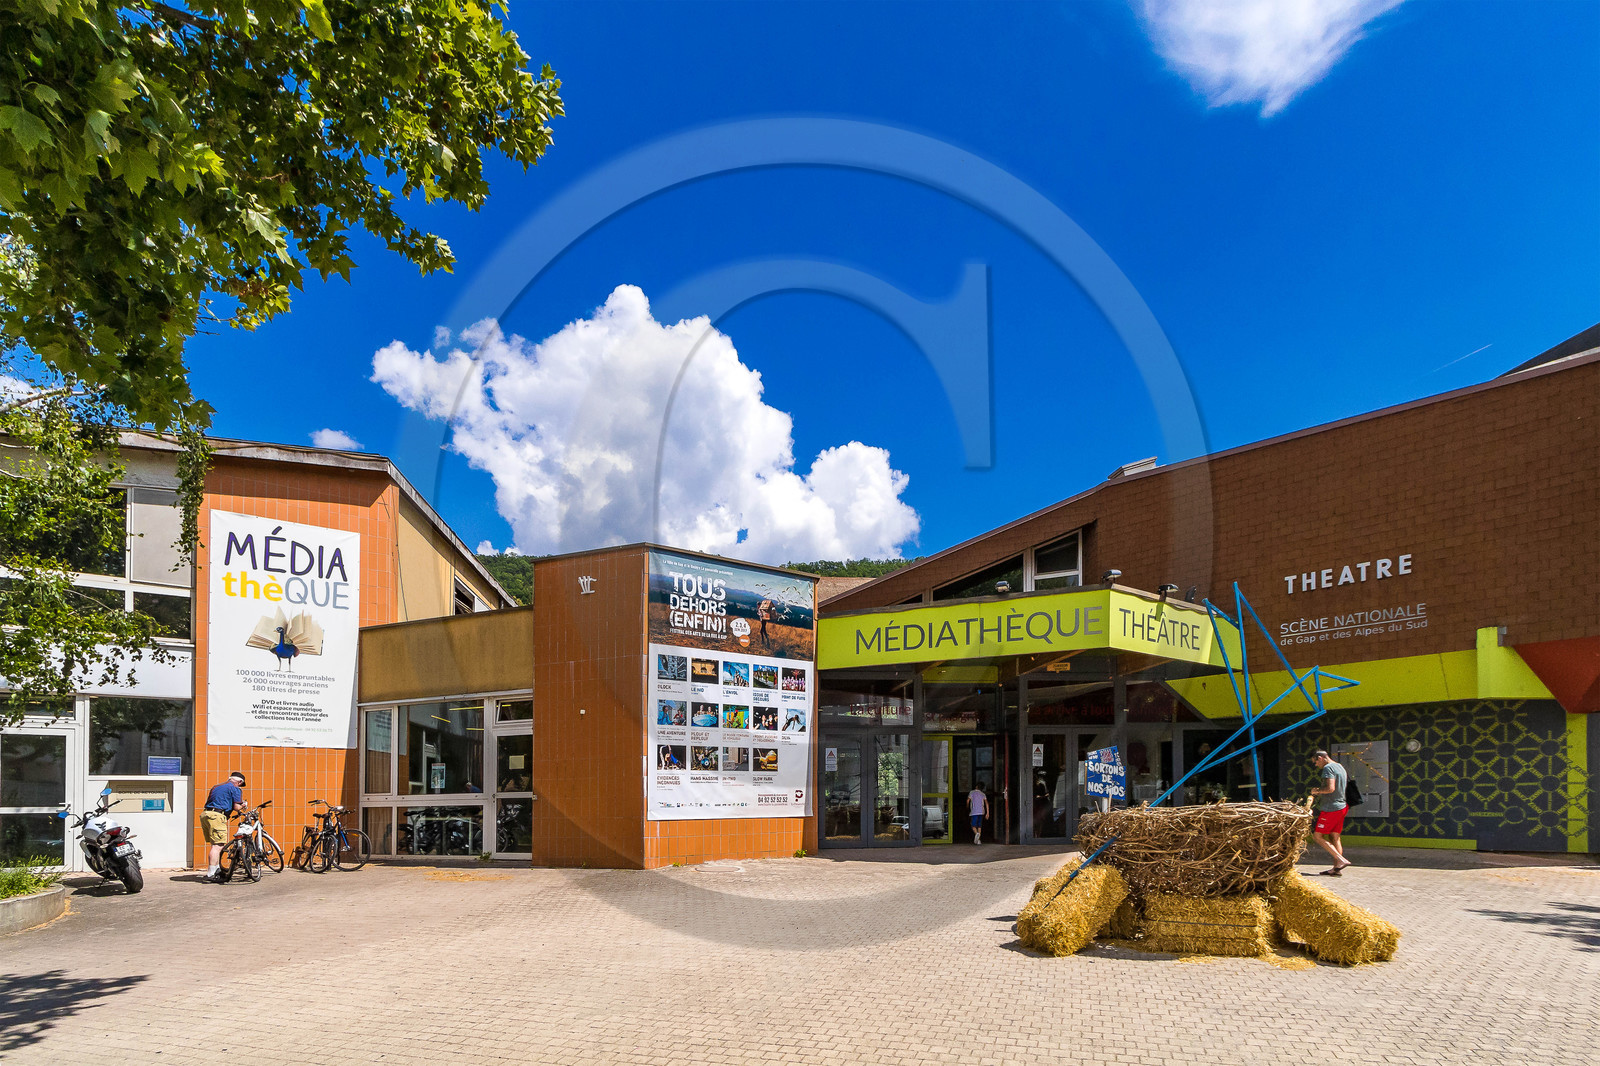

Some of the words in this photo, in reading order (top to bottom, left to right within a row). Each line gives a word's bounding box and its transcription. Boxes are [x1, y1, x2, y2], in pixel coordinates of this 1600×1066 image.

[224, 526, 348, 582] MÉDIA
[668, 571, 726, 600] TOUS
[1284, 554, 1412, 594] THEATRE
[670, 594, 726, 616] DEHORS
[1280, 617, 1328, 634] SCÈNE
[1334, 603, 1426, 627] NATIONALE
[670, 610, 726, 633] (ENFIN)!
[855, 604, 1103, 654] MÉDIATHÈQUE
[1119, 607, 1200, 650] THÉÂTRE
[1280, 638, 1292, 646] de
[1296, 635, 1316, 645] Gap
[1333, 630, 1351, 639] des
[1354, 626, 1384, 637] Alpes
[1388, 623, 1402, 632] du
[1406, 619, 1428, 630] Sud
[287, 673, 335, 682] empruntables
[1088, 761, 1125, 776] SORTONS
[1102, 774, 1113, 784] DE
[1088, 782, 1104, 794] NOS
